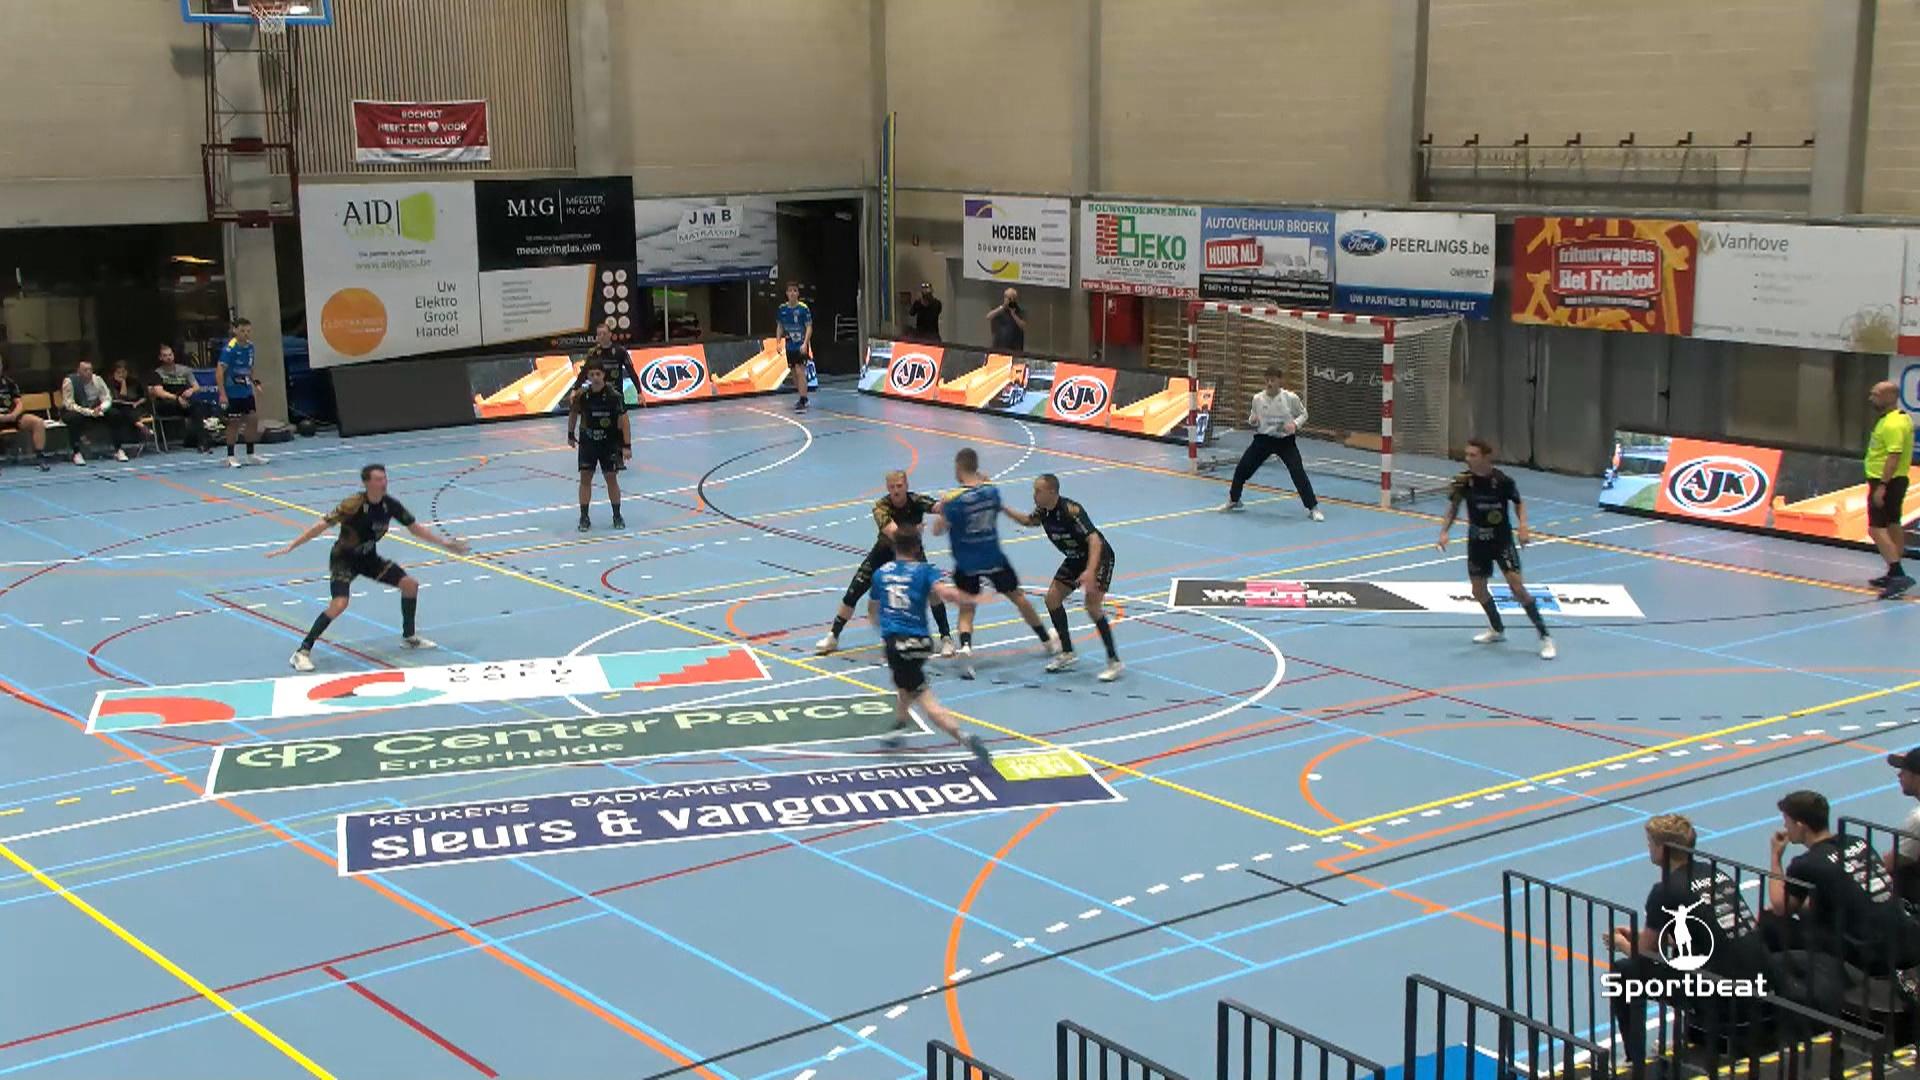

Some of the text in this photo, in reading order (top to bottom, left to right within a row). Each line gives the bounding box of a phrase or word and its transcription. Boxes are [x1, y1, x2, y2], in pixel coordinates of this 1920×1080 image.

[401, 110, 443, 119] BOCHOLT
[378, 122, 467, 133] HEEFT EEN VOOR
[507, 197, 555, 217] MIG
[565, 195, 604, 205] MEESTER
[343, 199, 393, 227] AID
[566, 205, 601, 215] IN GLAS
[1088, 203, 1197, 217] BOUWONDERNEMING
[991, 225, 1037, 242] HOEBEN
[1205, 217, 1329, 235] AUTOVERHUUR BROEKX
[1118, 215, 1187, 261] BEKO
[1347, 233, 1377, 251] Ford
[1390, 237, 1490, 255] PEERLINGS.be
[1717, 231, 1790, 252] Vanhove
[516, 243, 601, 256] meesteringlas.com
[977, 243, 1037, 256] bouwprojecten
[1209, 245, 1239, 265] HUUR
[1559, 245, 1656, 267] frituurwagens
[1096, 256, 1187, 271] SLEUTEL OP DE DEUR
[1450, 269, 1490, 279] OVERPELT
[1559, 269, 1656, 291] Het Frietkot
[437, 281, 457, 293] Uw
[415, 296, 458, 309] Elektro
[1349, 293, 1477, 311] UW PARTNER IN MOBILITEIT
[424, 310, 459, 323] Groot
[416, 324, 459, 338] Handel
[650, 364, 694, 392] AJK
[898, 362, 927, 387] AJK
[1061, 384, 1098, 411] AJK
[1681, 468, 1746, 504] AJK
[373, 700, 894, 756] Center Parcs
[369, 762, 970, 827] KEUKENS BADKAMERS INTERIEUR
[371, 776, 998, 861] sleurs & vangompel
